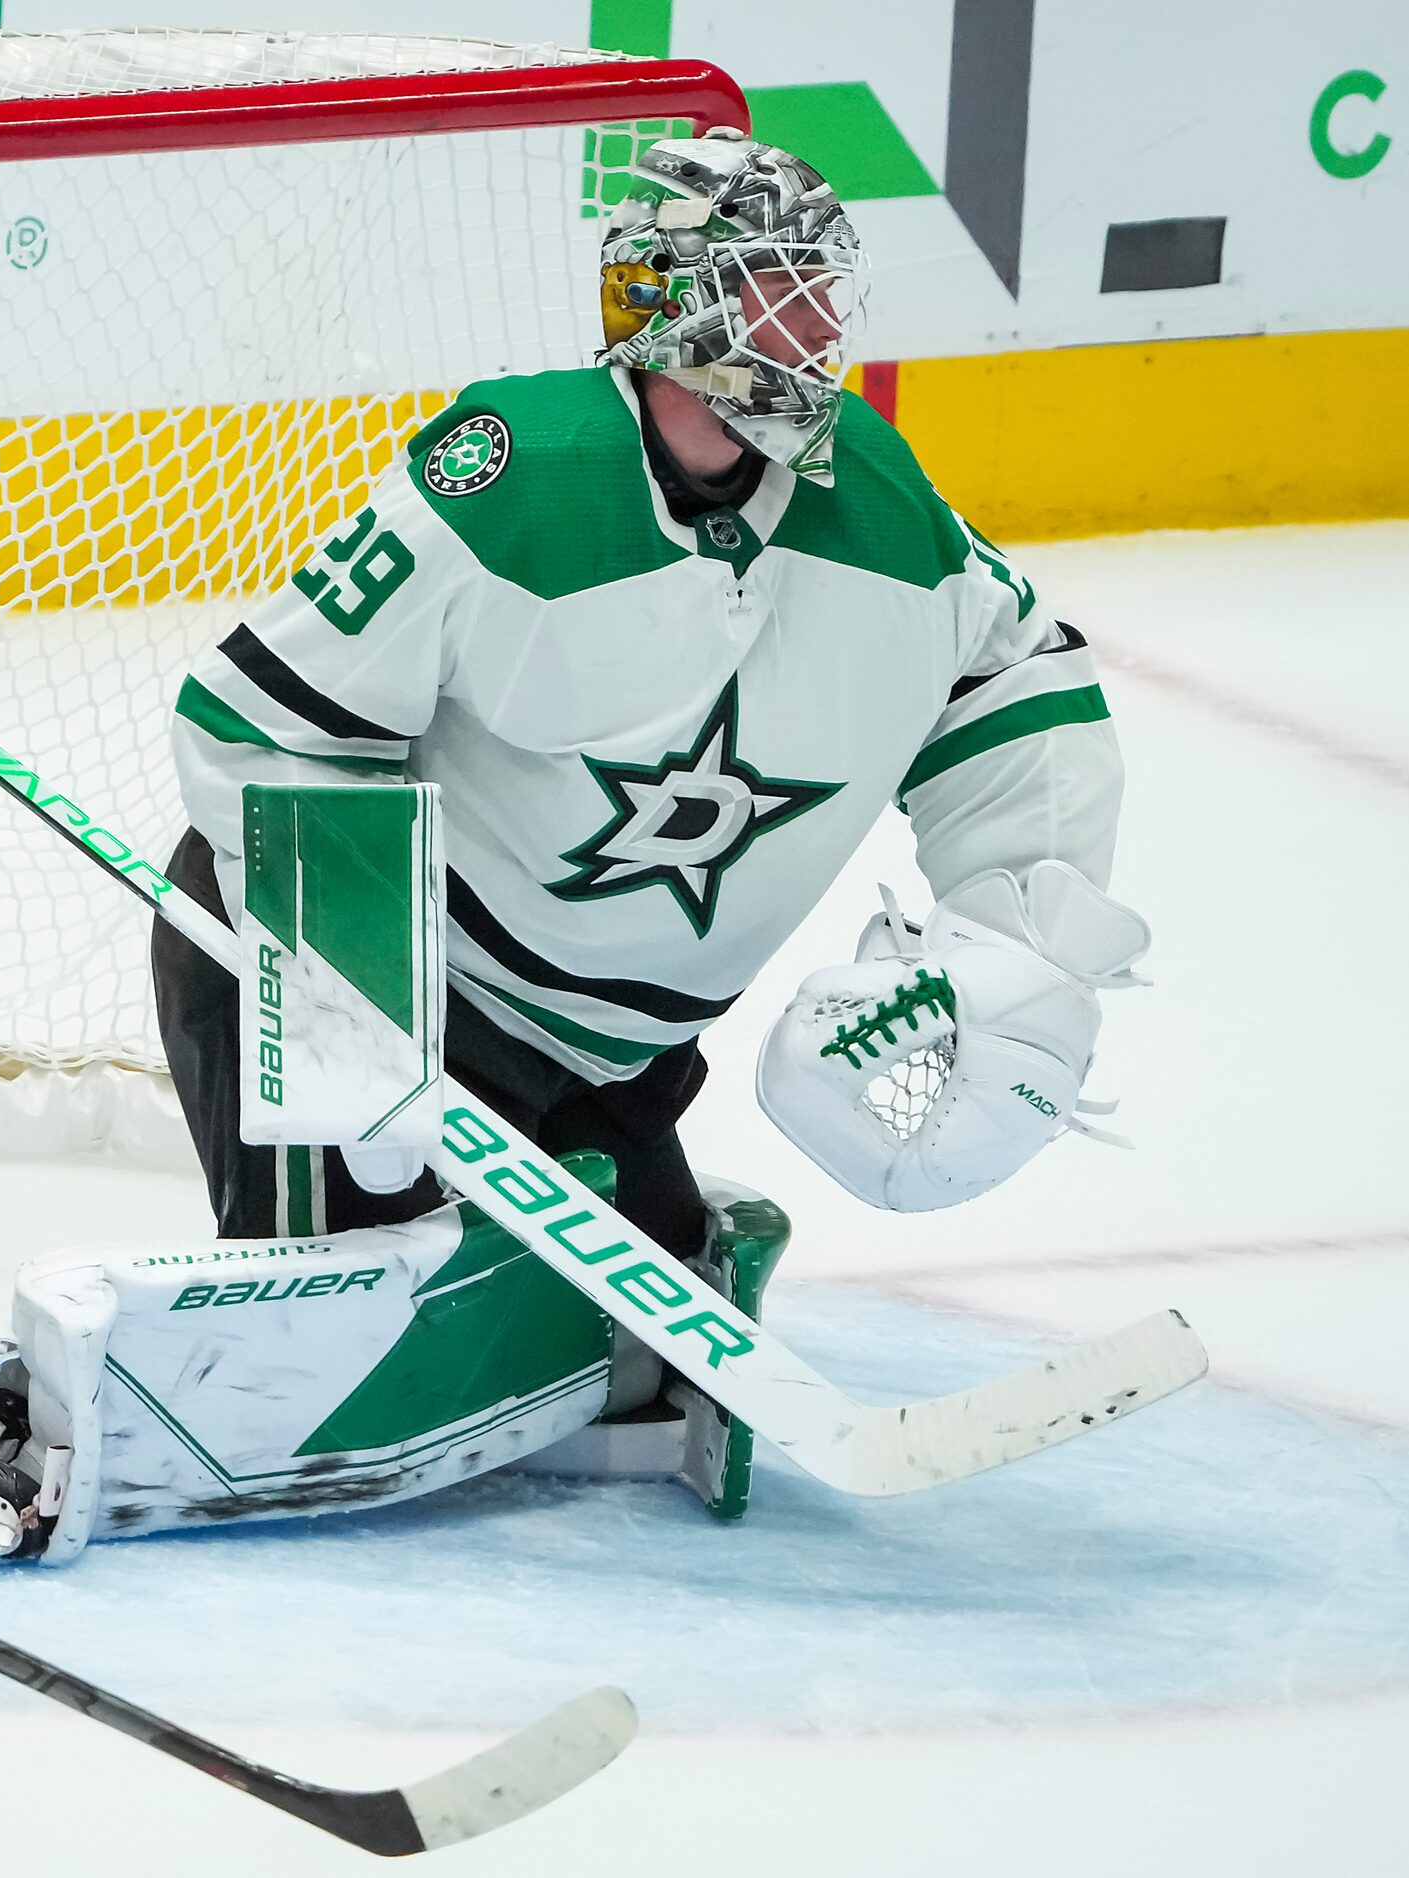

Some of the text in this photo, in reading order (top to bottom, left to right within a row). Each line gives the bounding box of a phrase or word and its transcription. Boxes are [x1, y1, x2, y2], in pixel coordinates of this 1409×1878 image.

[429, 420, 502, 490] DALLAS STARS
[291, 506, 416, 636] 29
[1009, 1083, 1062, 1120] MACH
